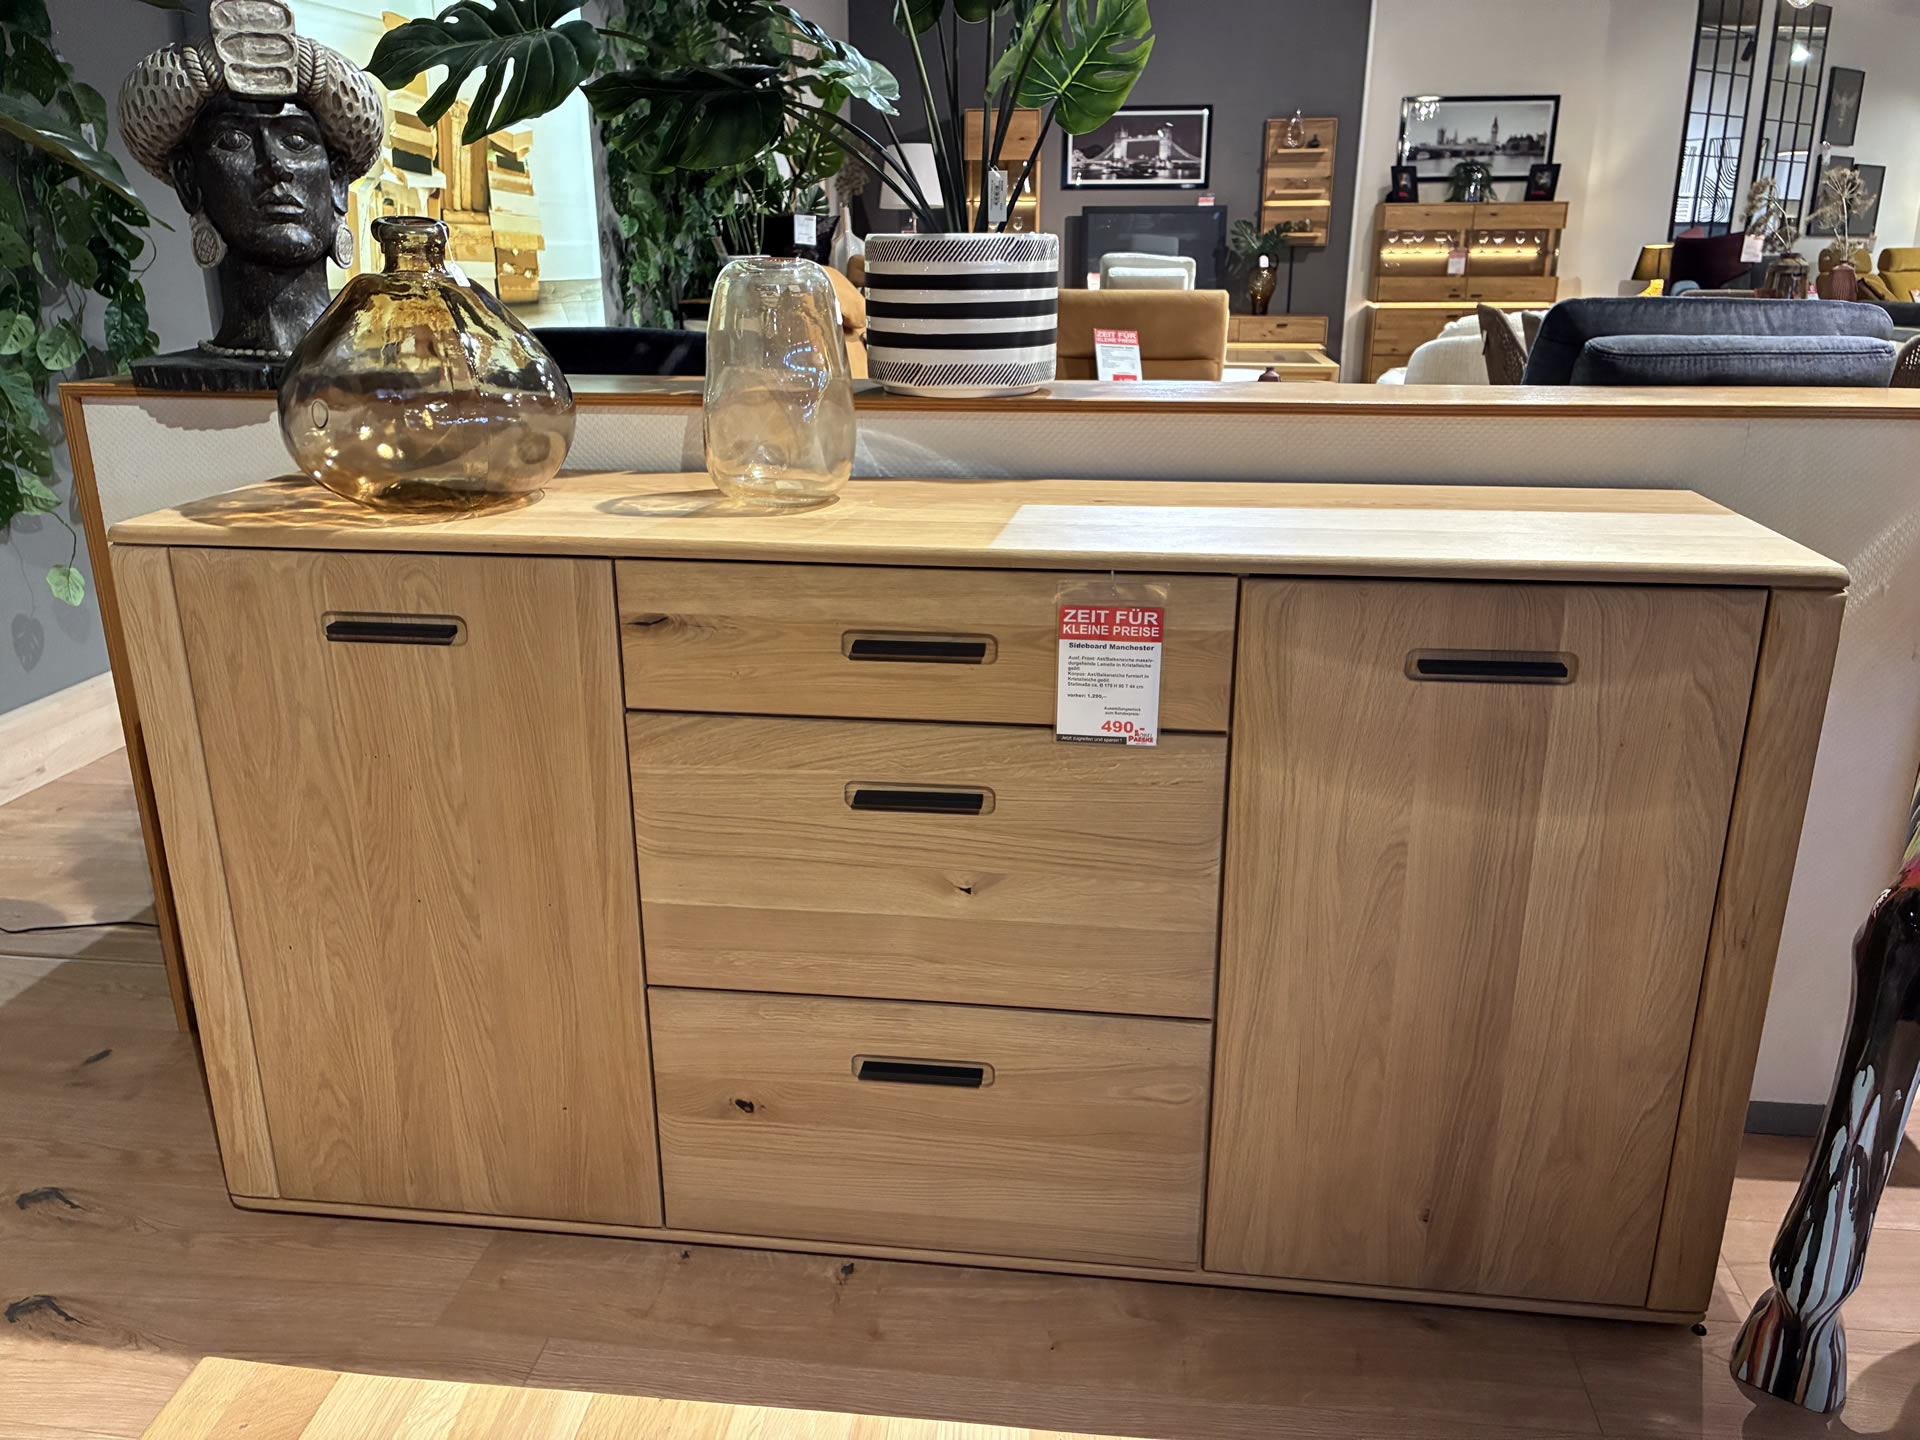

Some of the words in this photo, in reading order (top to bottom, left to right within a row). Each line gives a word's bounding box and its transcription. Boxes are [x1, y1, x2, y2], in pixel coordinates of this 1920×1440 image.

[1118, 331, 1136, 339] FÜR
[1063, 609, 1110, 623] ZEIT
[1116, 608, 1159, 626] FÜR
[1062, 624, 1109, 636] KLEINE
[1113, 625, 1160, 637] PREISE
[1068, 642, 1108, 650] Sideboard
[1109, 643, 1155, 652] Manchester
